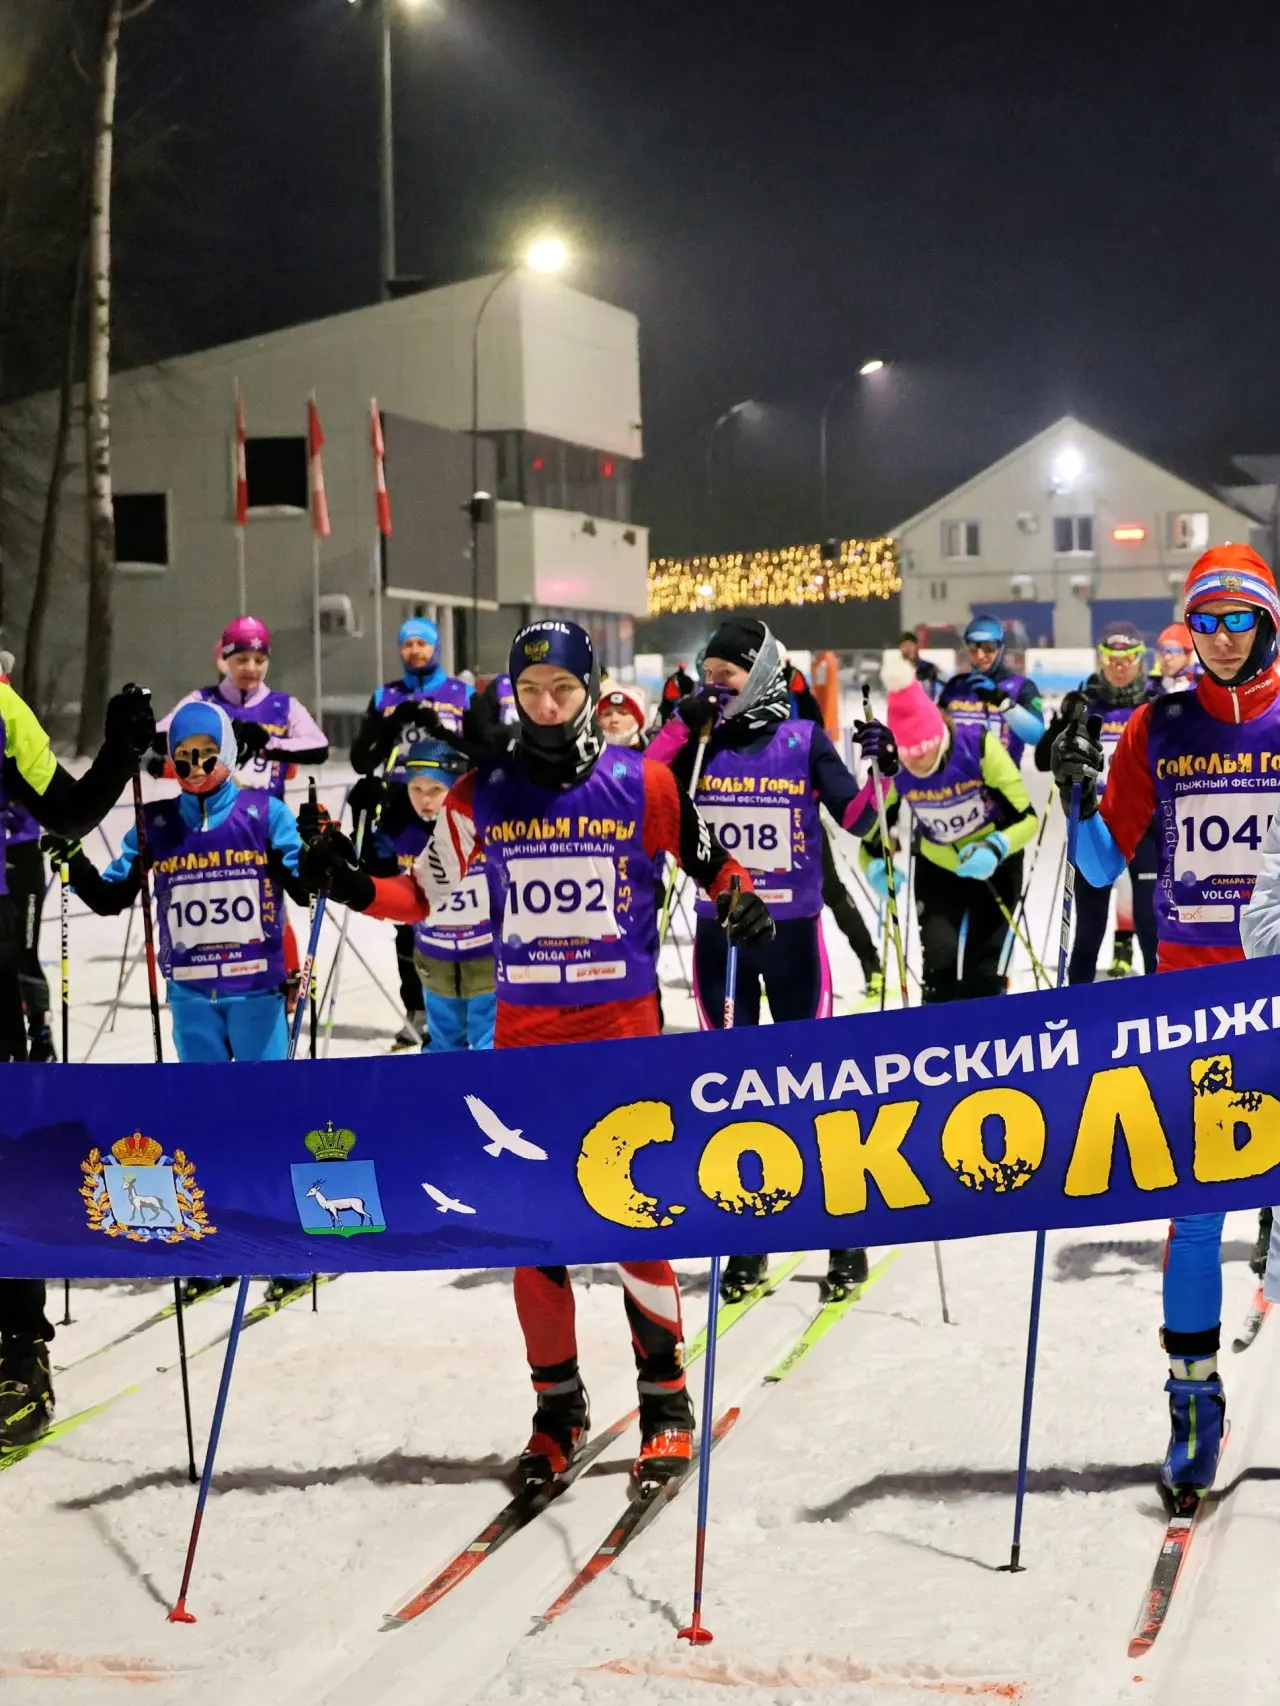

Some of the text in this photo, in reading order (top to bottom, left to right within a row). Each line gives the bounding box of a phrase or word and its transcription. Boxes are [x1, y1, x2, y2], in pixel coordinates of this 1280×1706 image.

[1157, 753, 1252, 780] СОКОЛЬИ
[760, 777, 806, 795] ГОРЫ
[1175, 777, 1228, 792] ЛЫЖНЫЙ
[738, 795, 790, 805] ФЕСТИВАЛЬ
[484, 816, 635, 846] СОКОЛЬИ ГОРЫ
[1181, 814, 1274, 852] 104
[549, 842, 615, 853] ФЕСТИВАЛЬ
[152, 849, 268, 876] СОКОЛЬИ ГОРЫ
[1212, 877, 1244, 885] САМАРА
[509, 879, 607, 914] 1092
[170, 895, 254, 928] 1030
[690, 1018, 1079, 1114] САМАРСКИЙ
